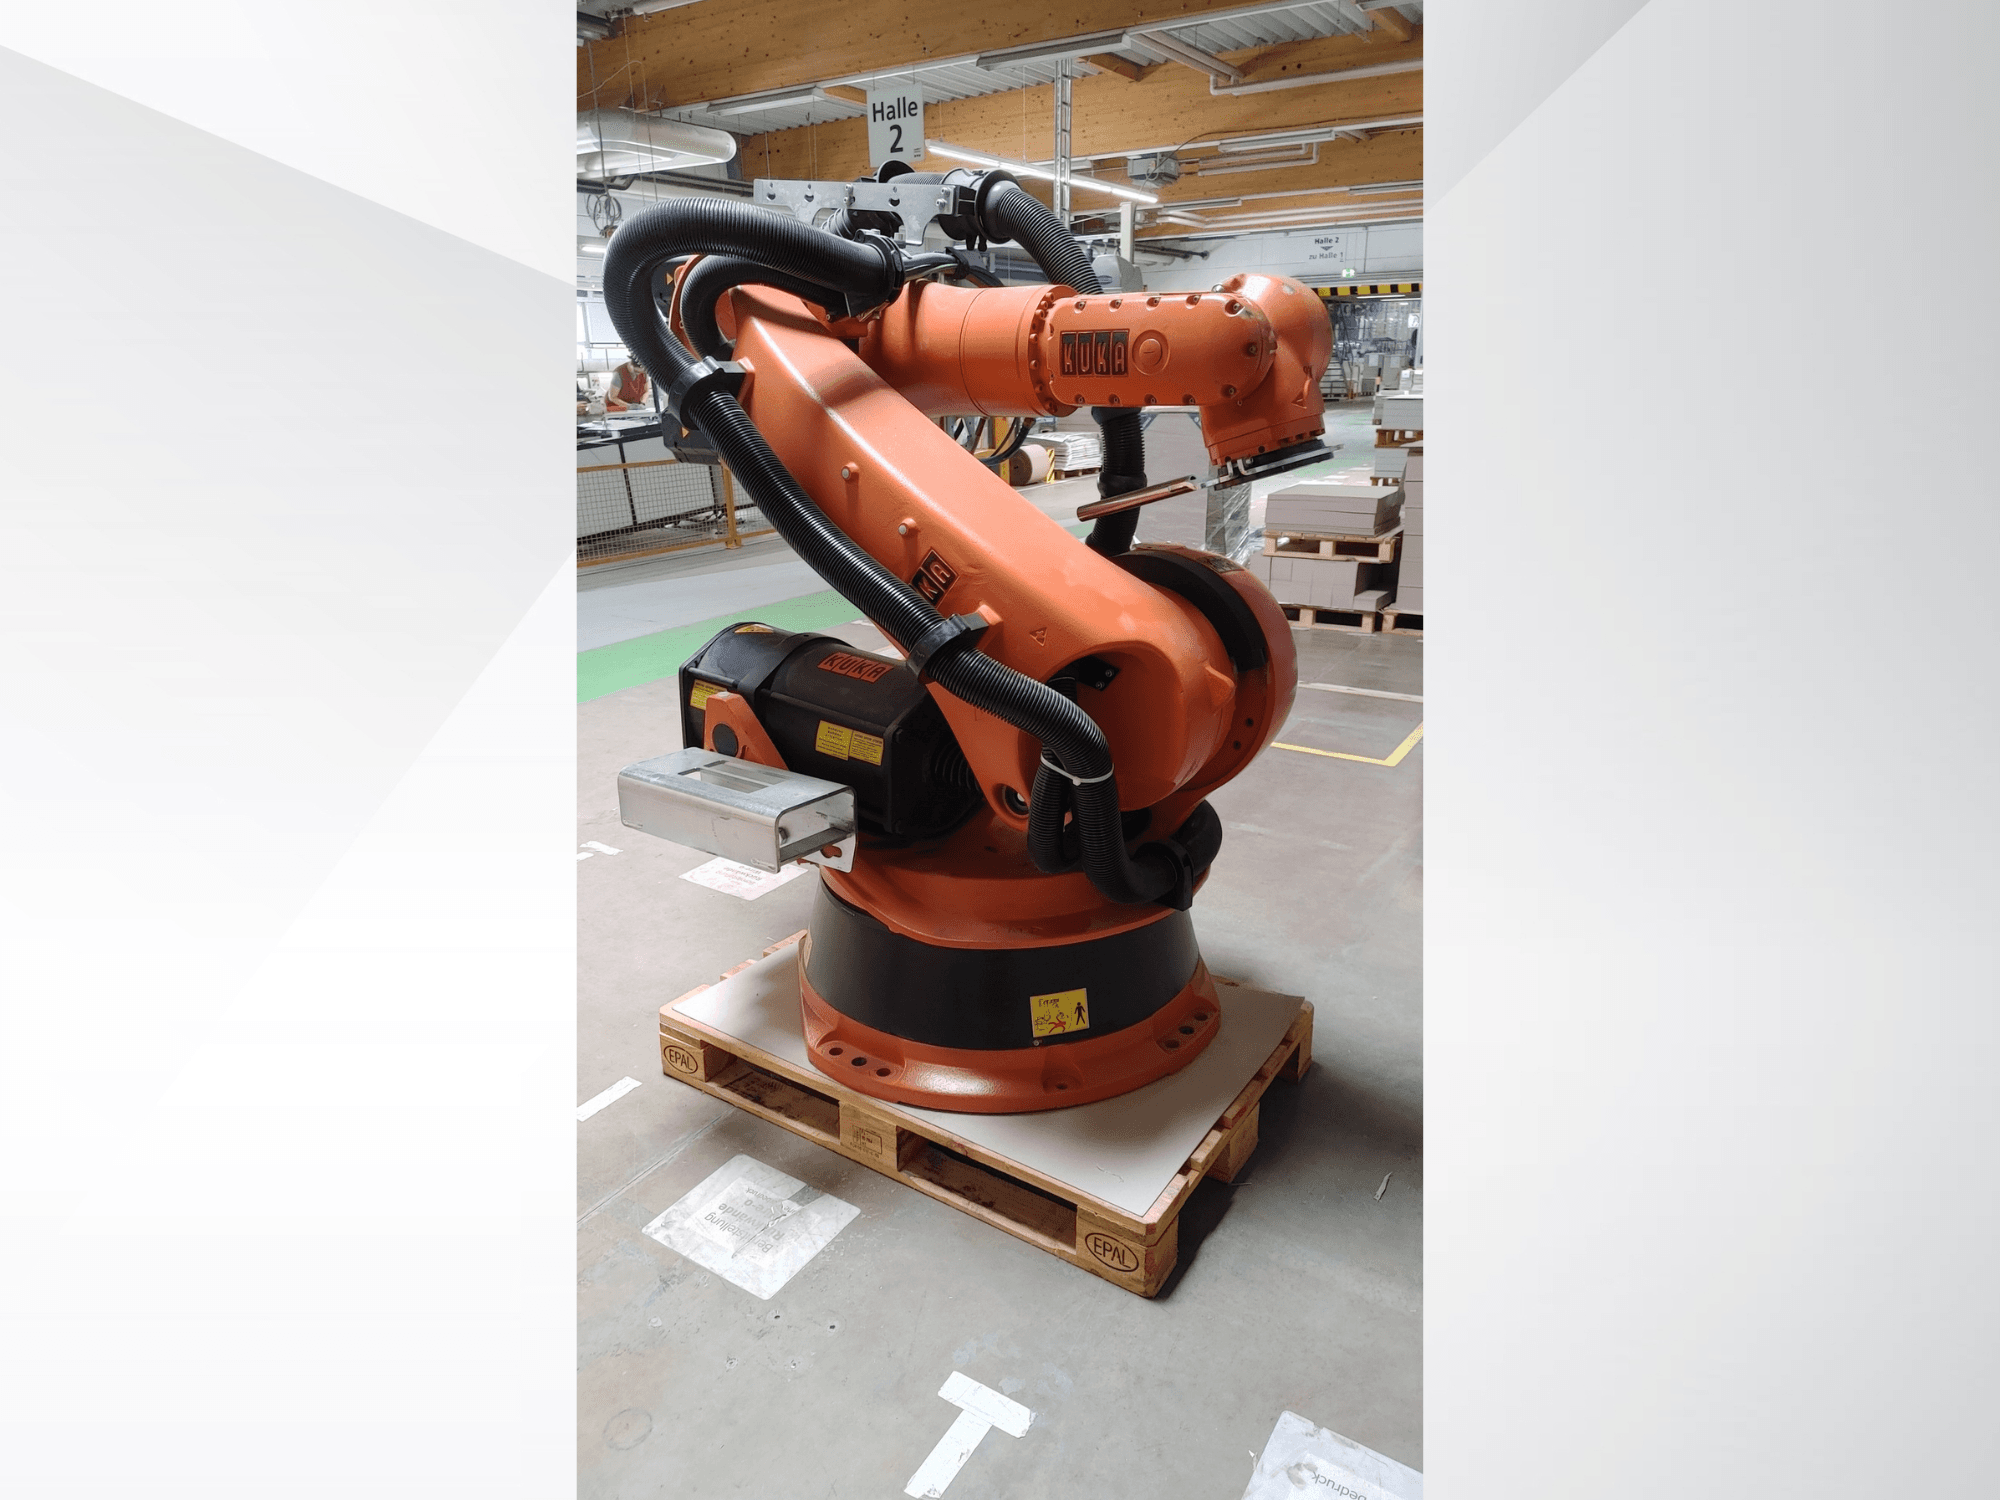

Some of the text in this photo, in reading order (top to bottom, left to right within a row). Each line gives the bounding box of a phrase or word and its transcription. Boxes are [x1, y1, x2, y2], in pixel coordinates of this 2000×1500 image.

[872, 96, 918, 123] Halle
[889, 124, 904, 154] 2
[1314, 236, 1340, 245] Halle 2
[1319, 252, 1338, 260] Halle
[1063, 340, 1126, 374] KUKA
[917, 560, 952, 602] KA
[823, 654, 887, 679] KUKA
[669, 1048, 694, 1071] EPAL
[704, 1212, 774, 1253] Beritstellung
[718, 1203, 785, 1240] Rükwände
[1093, 1236, 1132, 1269] EPAL
